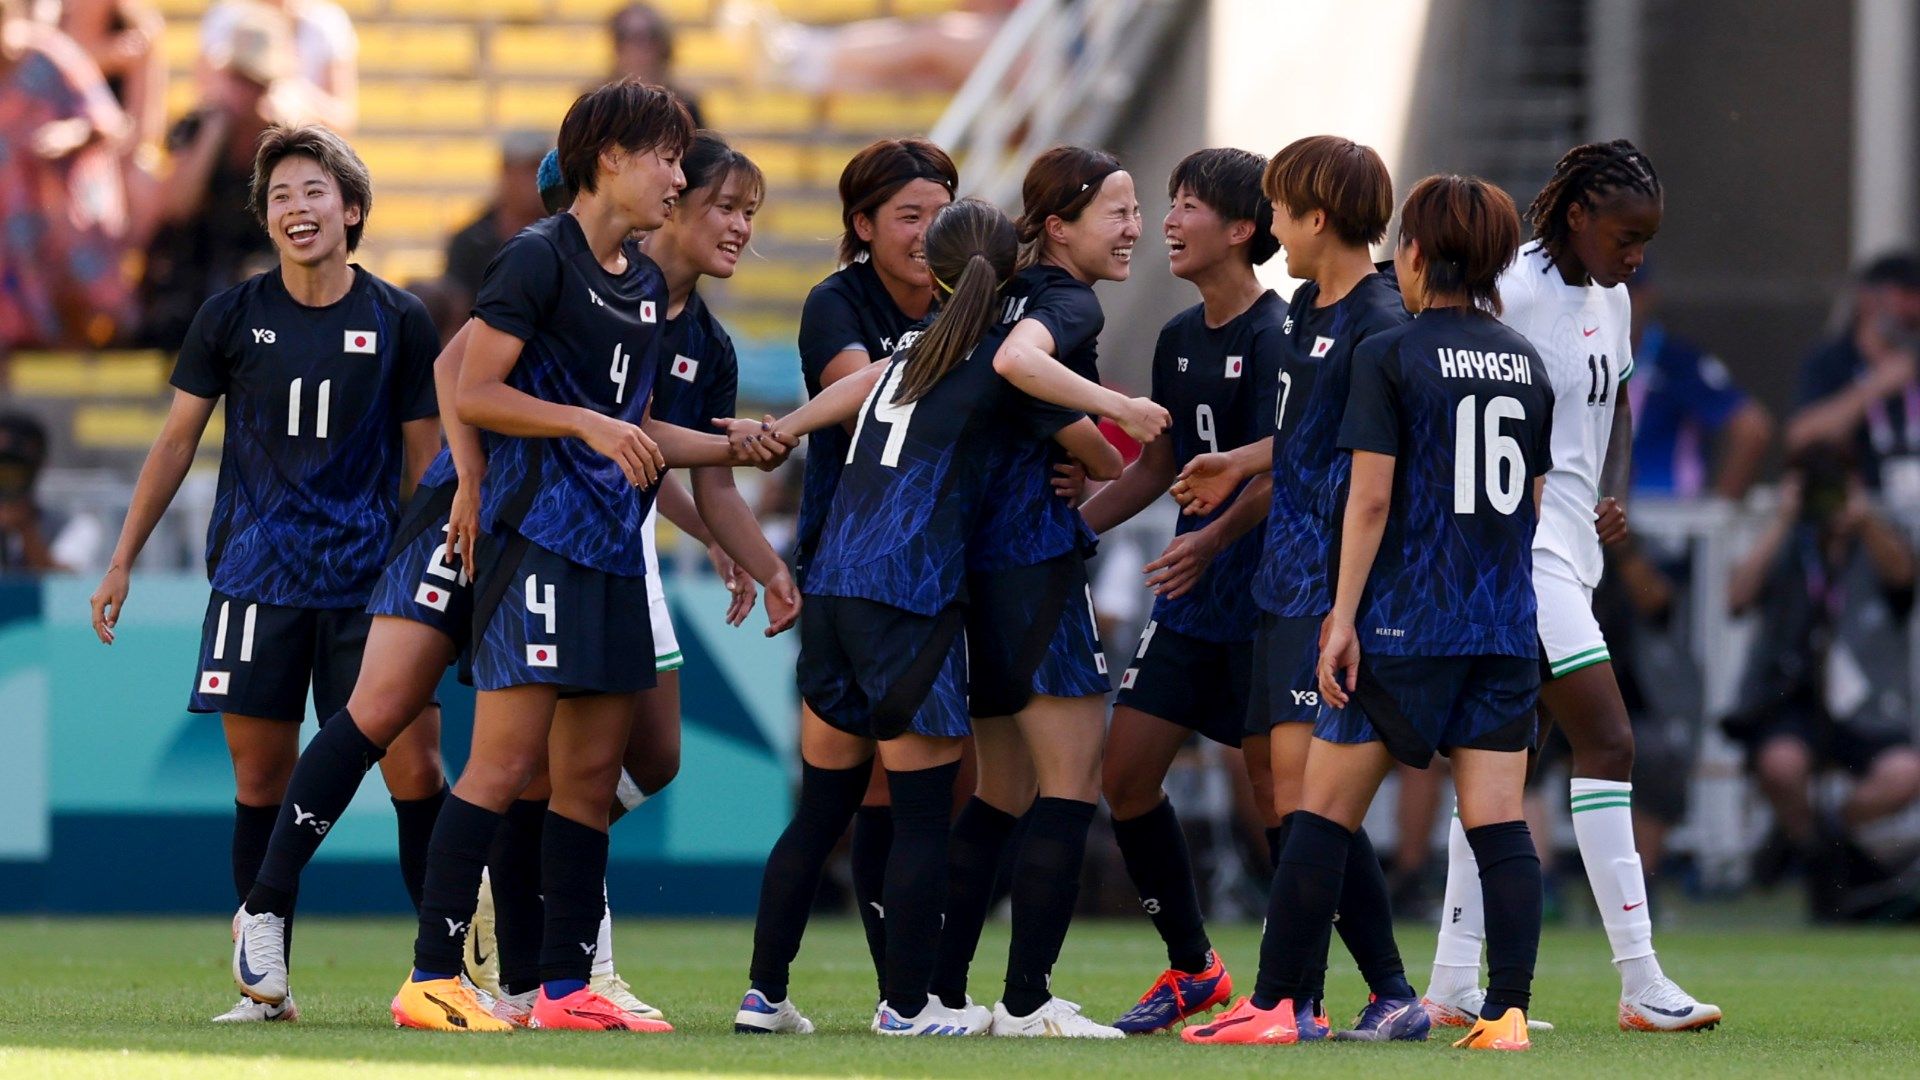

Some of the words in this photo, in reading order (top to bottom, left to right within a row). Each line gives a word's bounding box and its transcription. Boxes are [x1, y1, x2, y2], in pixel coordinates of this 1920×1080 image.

[252, 328, 277, 344] Y-3
[610, 342, 631, 404] 4
[1438, 348, 1532, 385] HAYASHI
[1587, 354, 1610, 406] 11
[287, 377, 331, 438] 11
[1196, 403, 1218, 454] 9
[1454, 394, 1526, 515] 16
[525, 573, 556, 634] 4
[213, 600, 257, 662] 11
[1290, 689, 1318, 706] Y-3
[294, 803, 331, 835] Y-3
